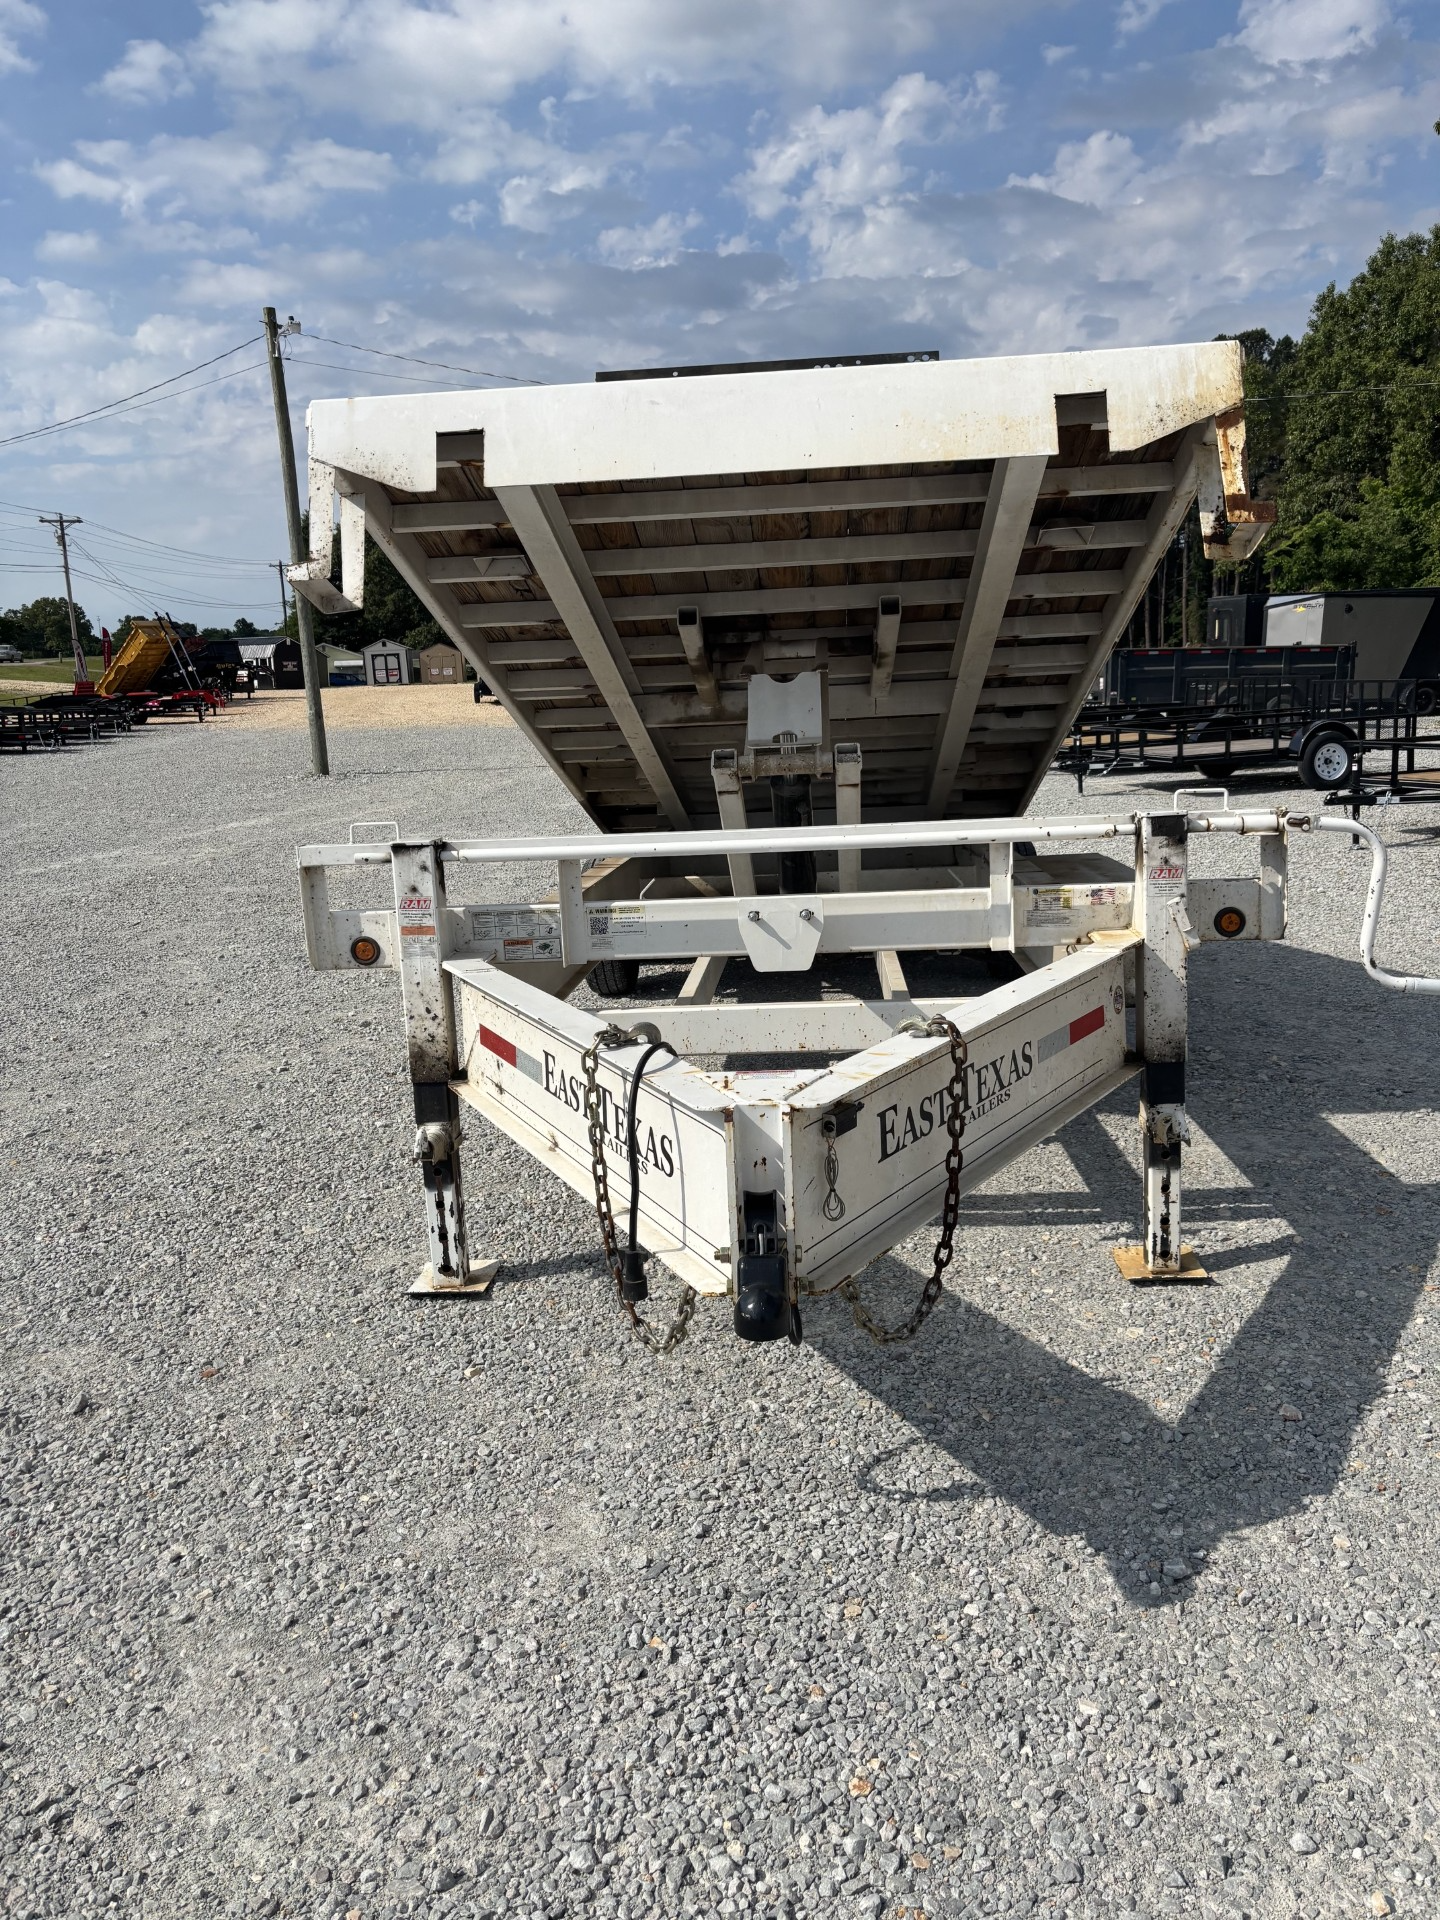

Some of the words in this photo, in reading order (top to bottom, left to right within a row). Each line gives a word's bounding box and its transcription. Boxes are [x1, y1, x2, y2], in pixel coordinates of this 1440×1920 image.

[1149, 868, 1183, 879] RAM
[400, 899, 432, 909] RAM
[543, 1049, 591, 1121] EAST
[877, 1085, 951, 1164] EAST
[957, 1040, 1033, 1113] TEXAS
